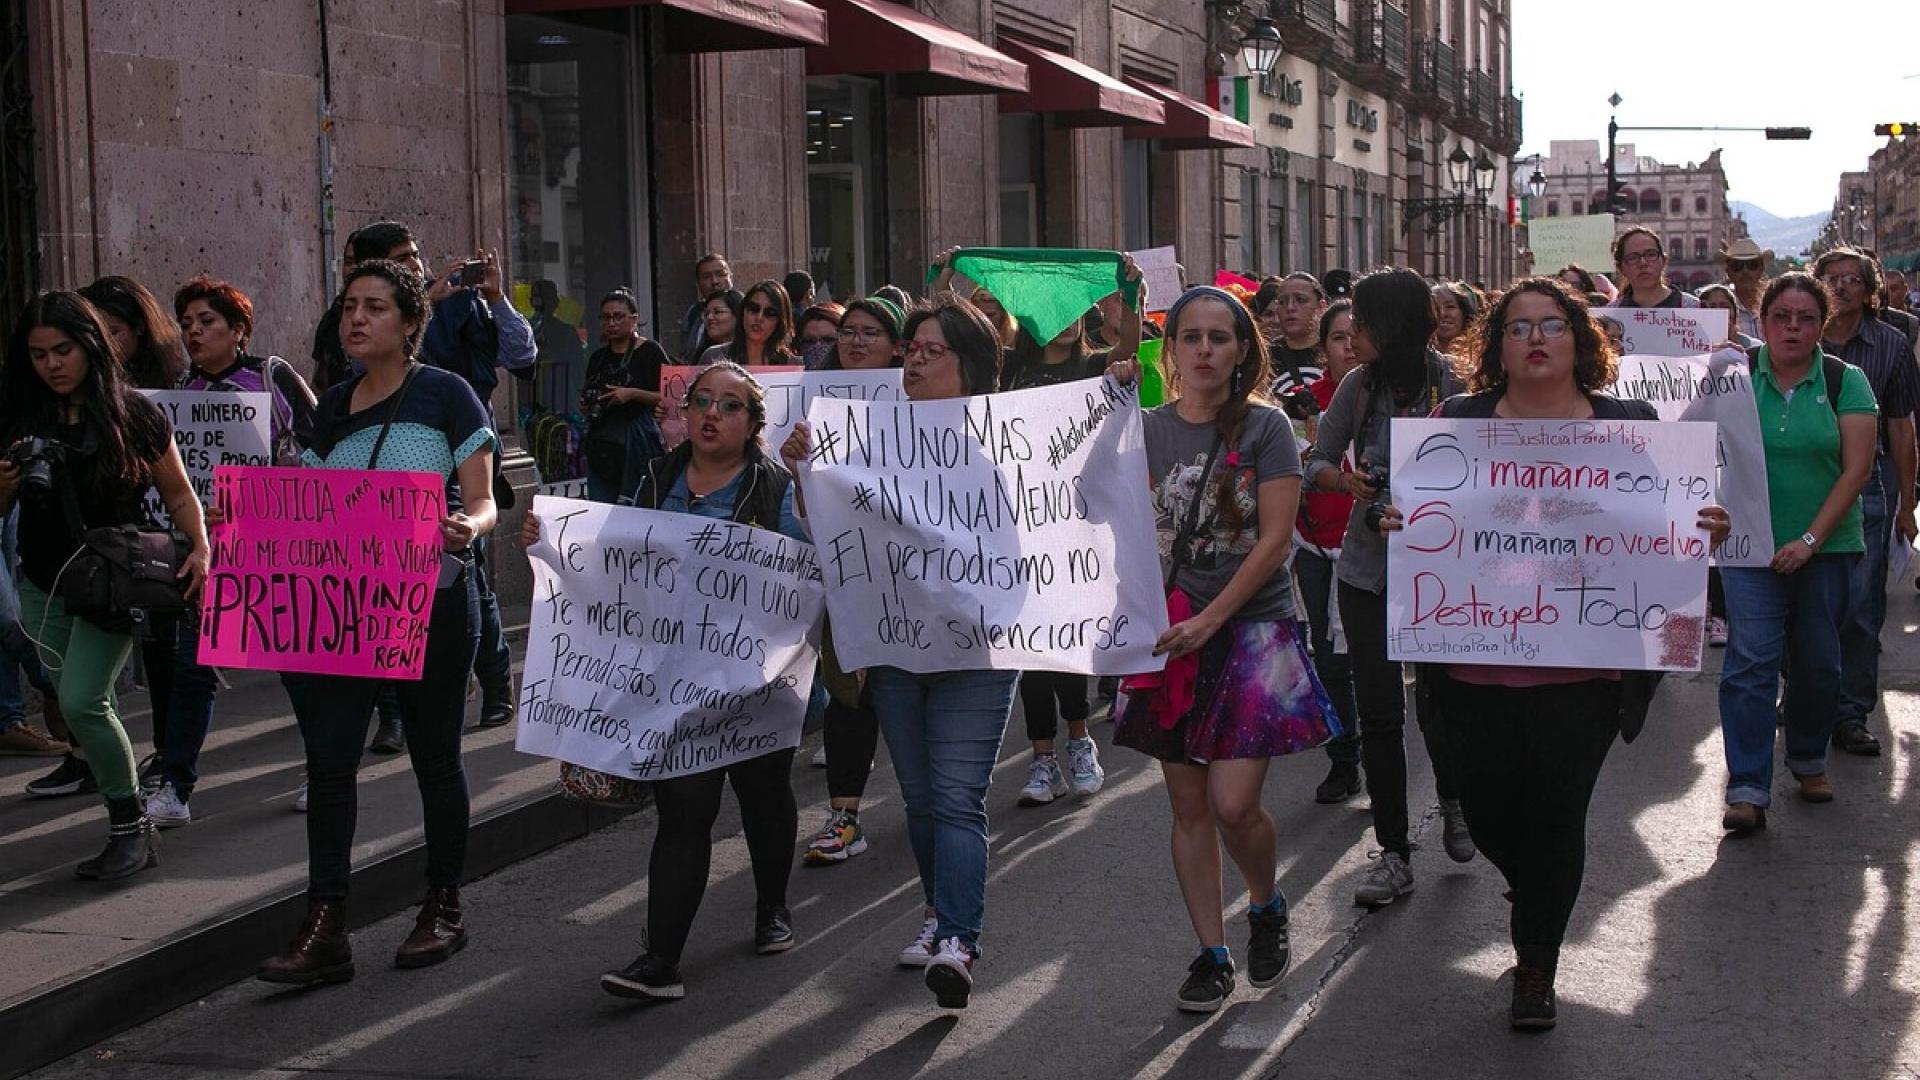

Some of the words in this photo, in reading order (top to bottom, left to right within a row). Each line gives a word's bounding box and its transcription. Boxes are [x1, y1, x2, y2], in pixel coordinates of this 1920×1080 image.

[1632, 310, 1697, 327] #Justicia
[1682, 337, 1712, 352] Mitz
[191, 399, 257, 424] NÚMERO
[204, 430, 225, 447] DE
[1413, 433, 1479, 491] Si
[1490, 459, 1609, 491] mañana
[1614, 471, 1670, 503] soy
[345, 478, 374, 512] PARA
[379, 487, 444, 523] MITZY
[256, 538, 283, 568] ME
[361, 534, 385, 569] ME
[685, 522, 824, 584] #JusticiaParaMitz
[1405, 501, 1465, 559] Si
[1473, 531, 1578, 557] mañana
[1585, 532, 1614, 557] no
[555, 508, 589, 573] Te
[604, 524, 680, 594] metes
[695, 566, 748, 606] con
[761, 580, 800, 620] uno
[829, 527, 872, 587] El
[885, 535, 1054, 603] periodismo
[1067, 546, 1101, 585] no
[545, 578, 574, 626] te
[586, 583, 644, 638] metes
[652, 616, 685, 645] con
[877, 592, 933, 651] debe
[946, 604, 1130, 652] silenciarse
[1553, 576, 1669, 632] Todo
[374, 643, 421, 674] REN!
[631, 731, 778, 778] #NiUnoMenos
[638, 712, 753, 750] conductores
